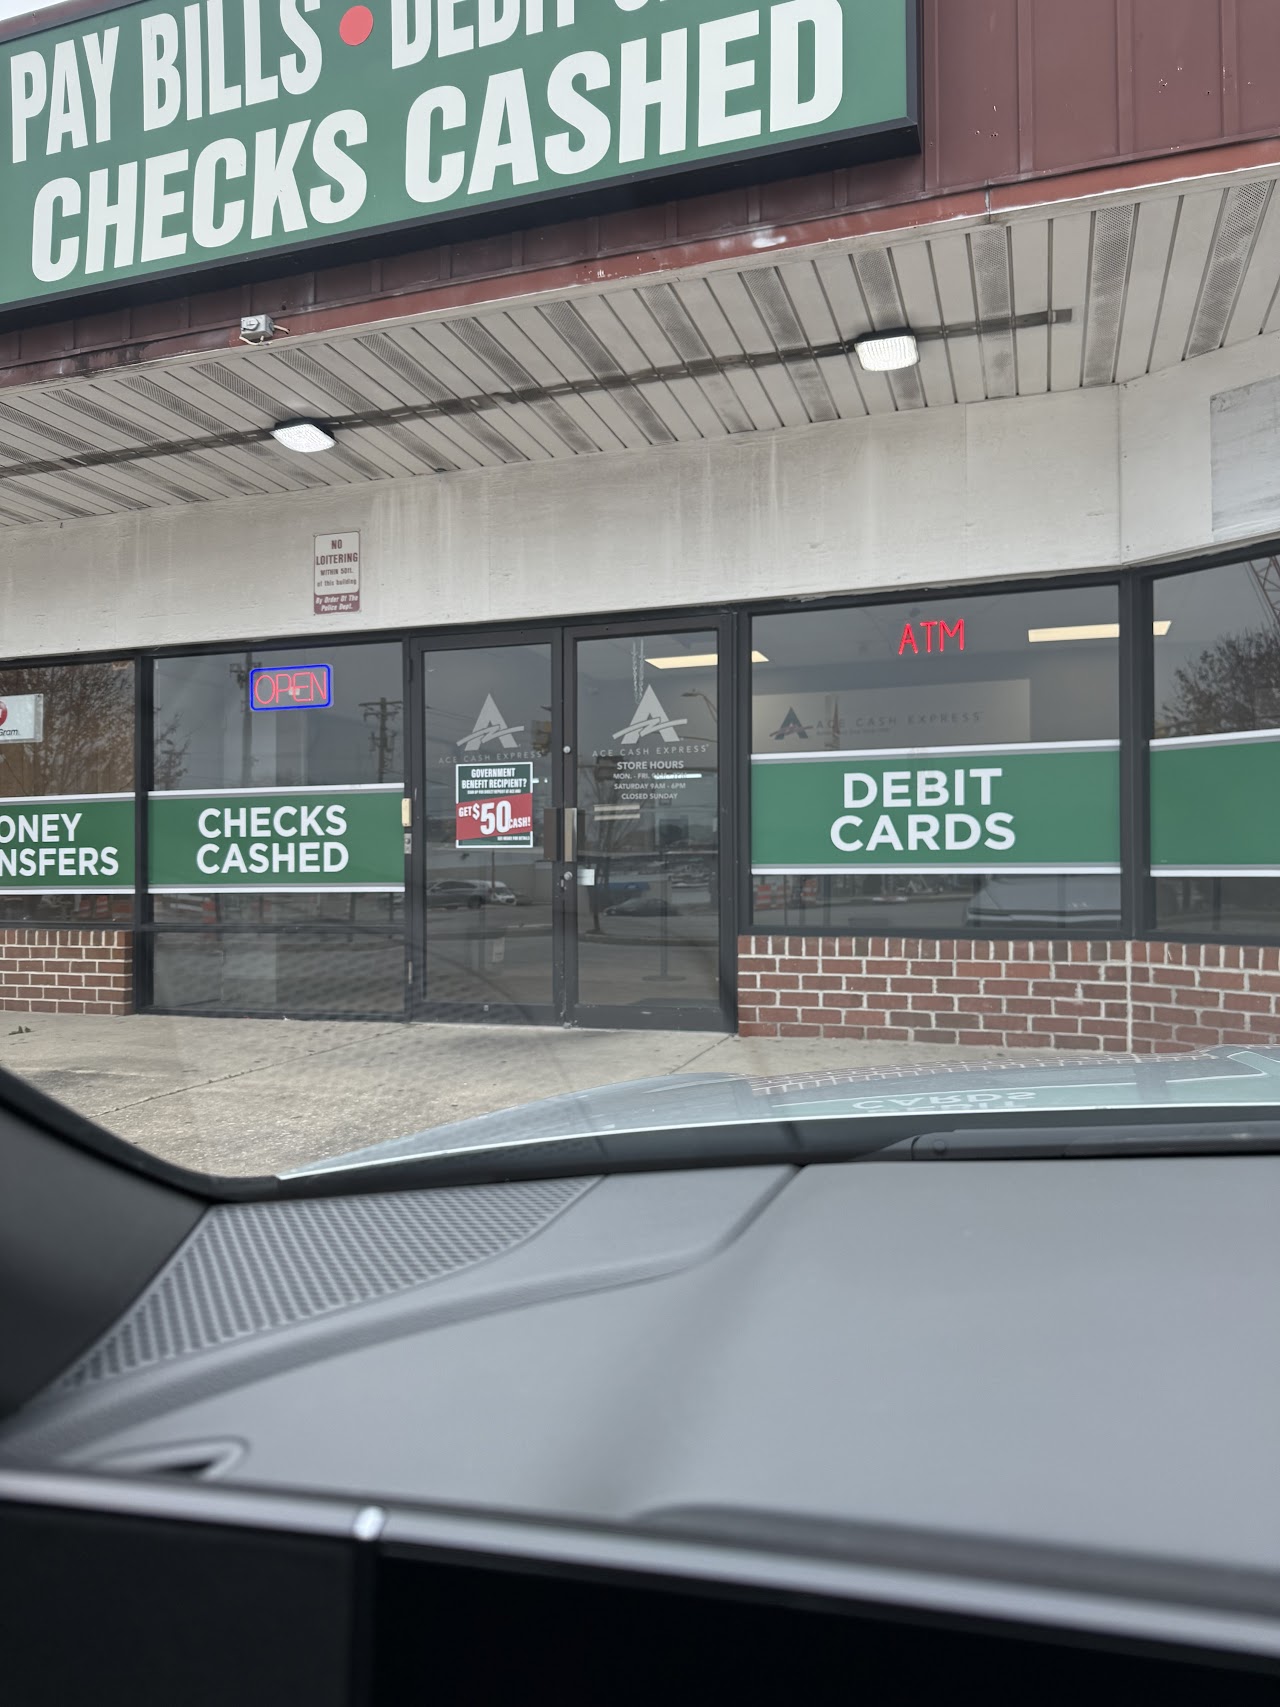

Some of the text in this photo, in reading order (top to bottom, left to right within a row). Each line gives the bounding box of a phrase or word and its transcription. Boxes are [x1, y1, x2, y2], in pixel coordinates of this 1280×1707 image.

[10, 26, 120, 164] PAY
[140, 0, 323, 132] BILLS
[31, 0, 844, 283] CHECKS CASHED
[331, 539, 343, 549] NO
[316, 552, 358, 566] LOITERING
[336, 578, 357, 586] building
[321, 604, 338, 612] Police
[324, 596, 340, 604] Order
[898, 618, 966, 655] ATM
[254, 671, 327, 704] OPEN
[855, 716, 897, 727] CASH
[907, 711, 980, 725] EXPRESS
[463, 755, 491, 763] CASH
[592, 749, 614, 757] ACE
[620, 748, 649, 756] CASH
[471, 768, 516, 778] GOVERNMENT
[616, 760, 684, 770] STORE HOURS
[461, 778, 527, 789] BENEFIT RECIPIENT?
[844, 768, 1003, 808] DEBIT
[198, 804, 347, 838] CHECKS
[458, 800, 531, 835] GET $50 CASH!
[0, 813, 82, 843] ONEY
[830, 812, 1016, 852] CARDS
[196, 841, 349, 874] CASHED
